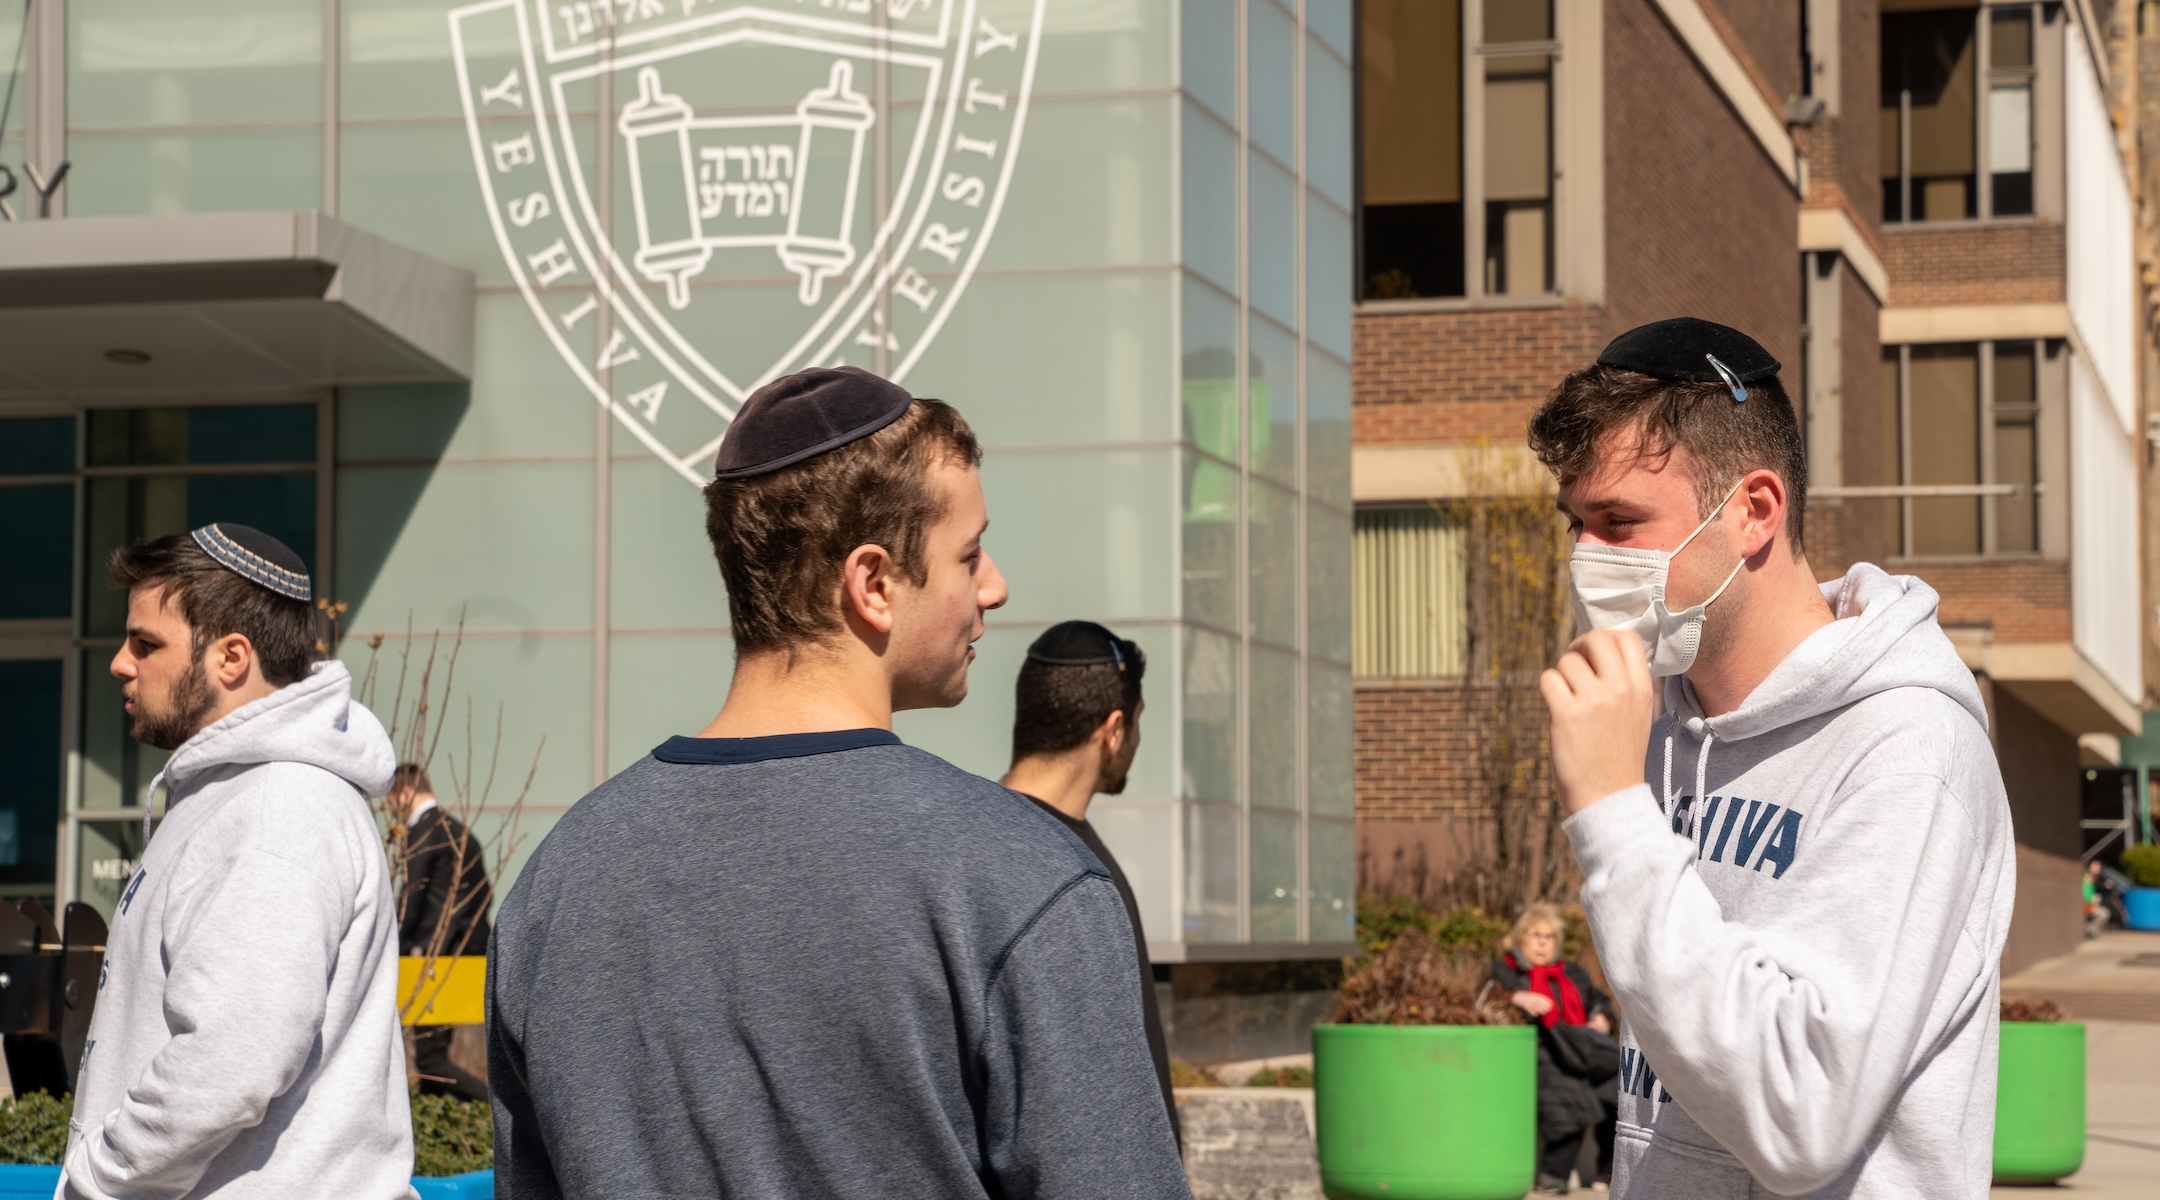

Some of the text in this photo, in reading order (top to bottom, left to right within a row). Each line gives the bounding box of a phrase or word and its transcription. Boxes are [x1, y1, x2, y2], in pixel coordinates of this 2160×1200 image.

[699, 144, 794, 182] תורה
[699, 180, 790, 219] ומדע
[828, 15, 1019, 371] VERSITY
[481, 66, 669, 424] YESHIVA
[1660, 795, 1803, 880] SHIVA
